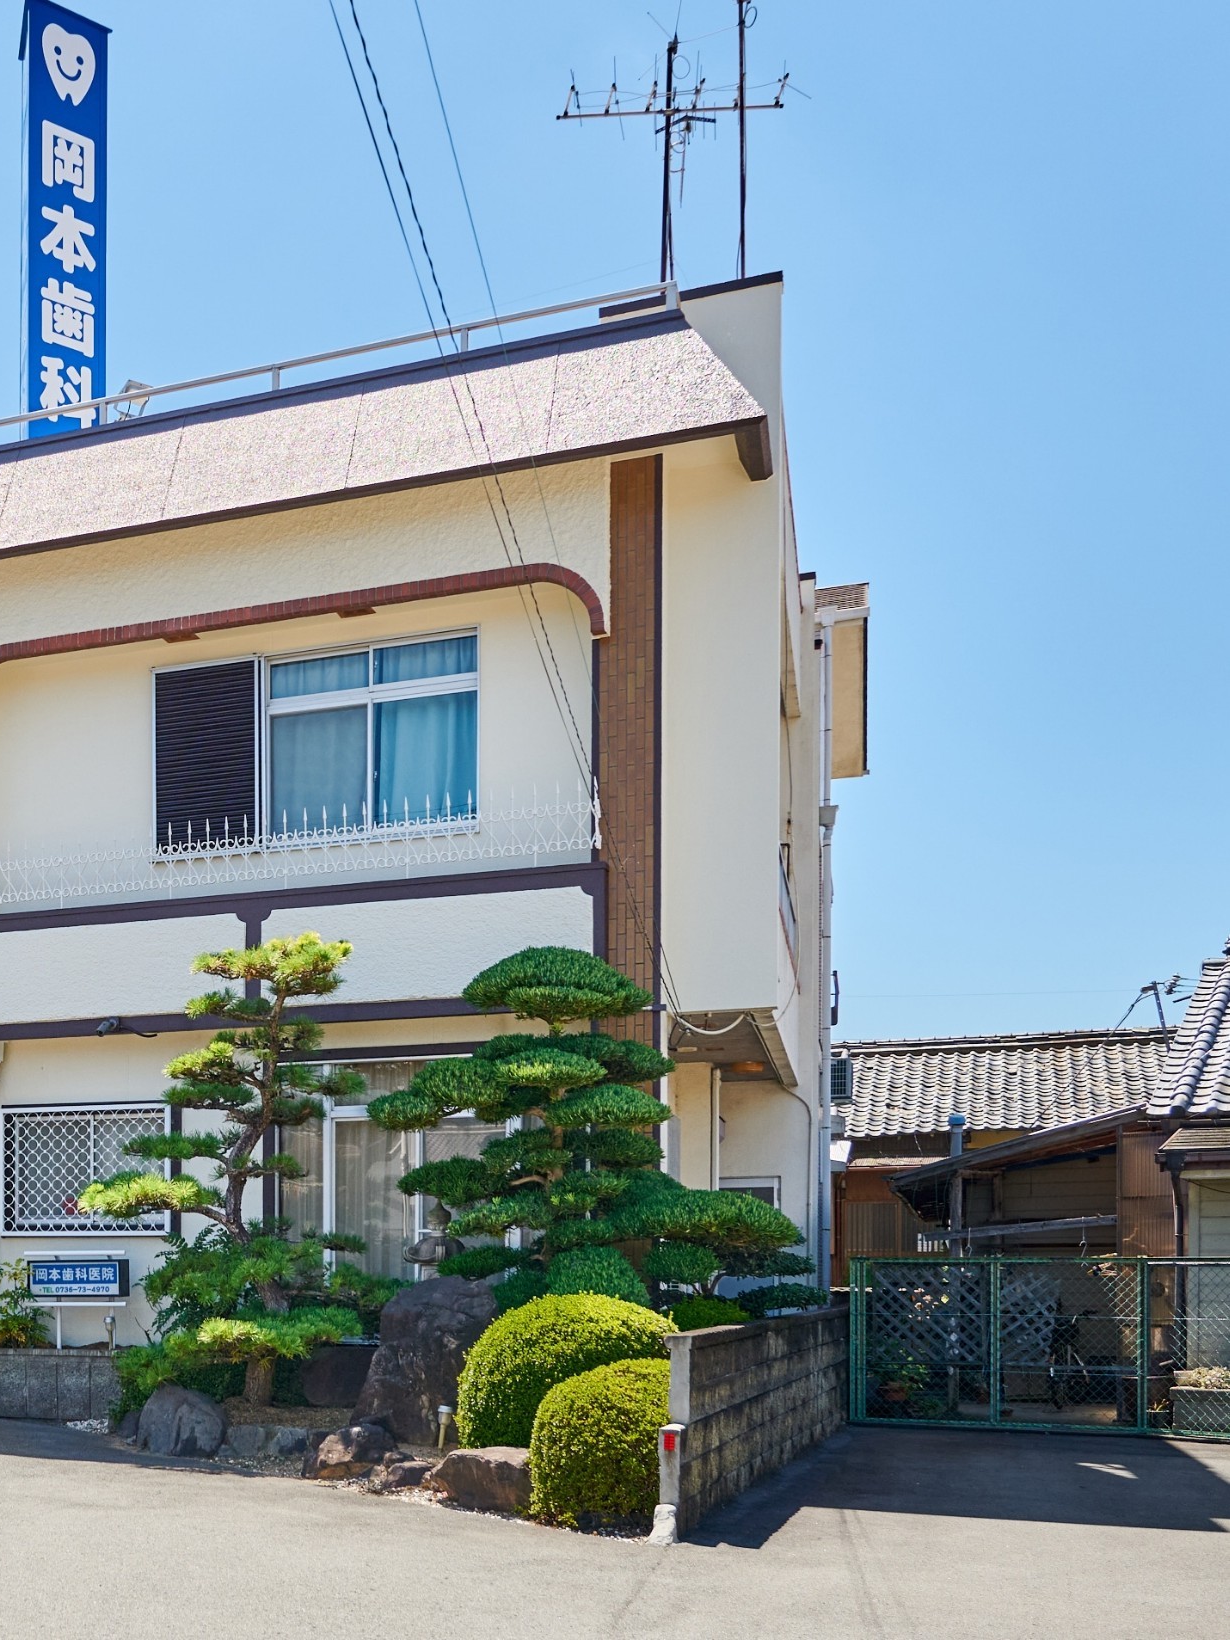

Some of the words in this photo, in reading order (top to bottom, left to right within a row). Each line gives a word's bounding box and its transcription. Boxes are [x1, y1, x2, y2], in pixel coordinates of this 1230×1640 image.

[40, 119, 96, 429] 岡本歯科
[35, 1267, 114, 1282] 岡本歯科医院
